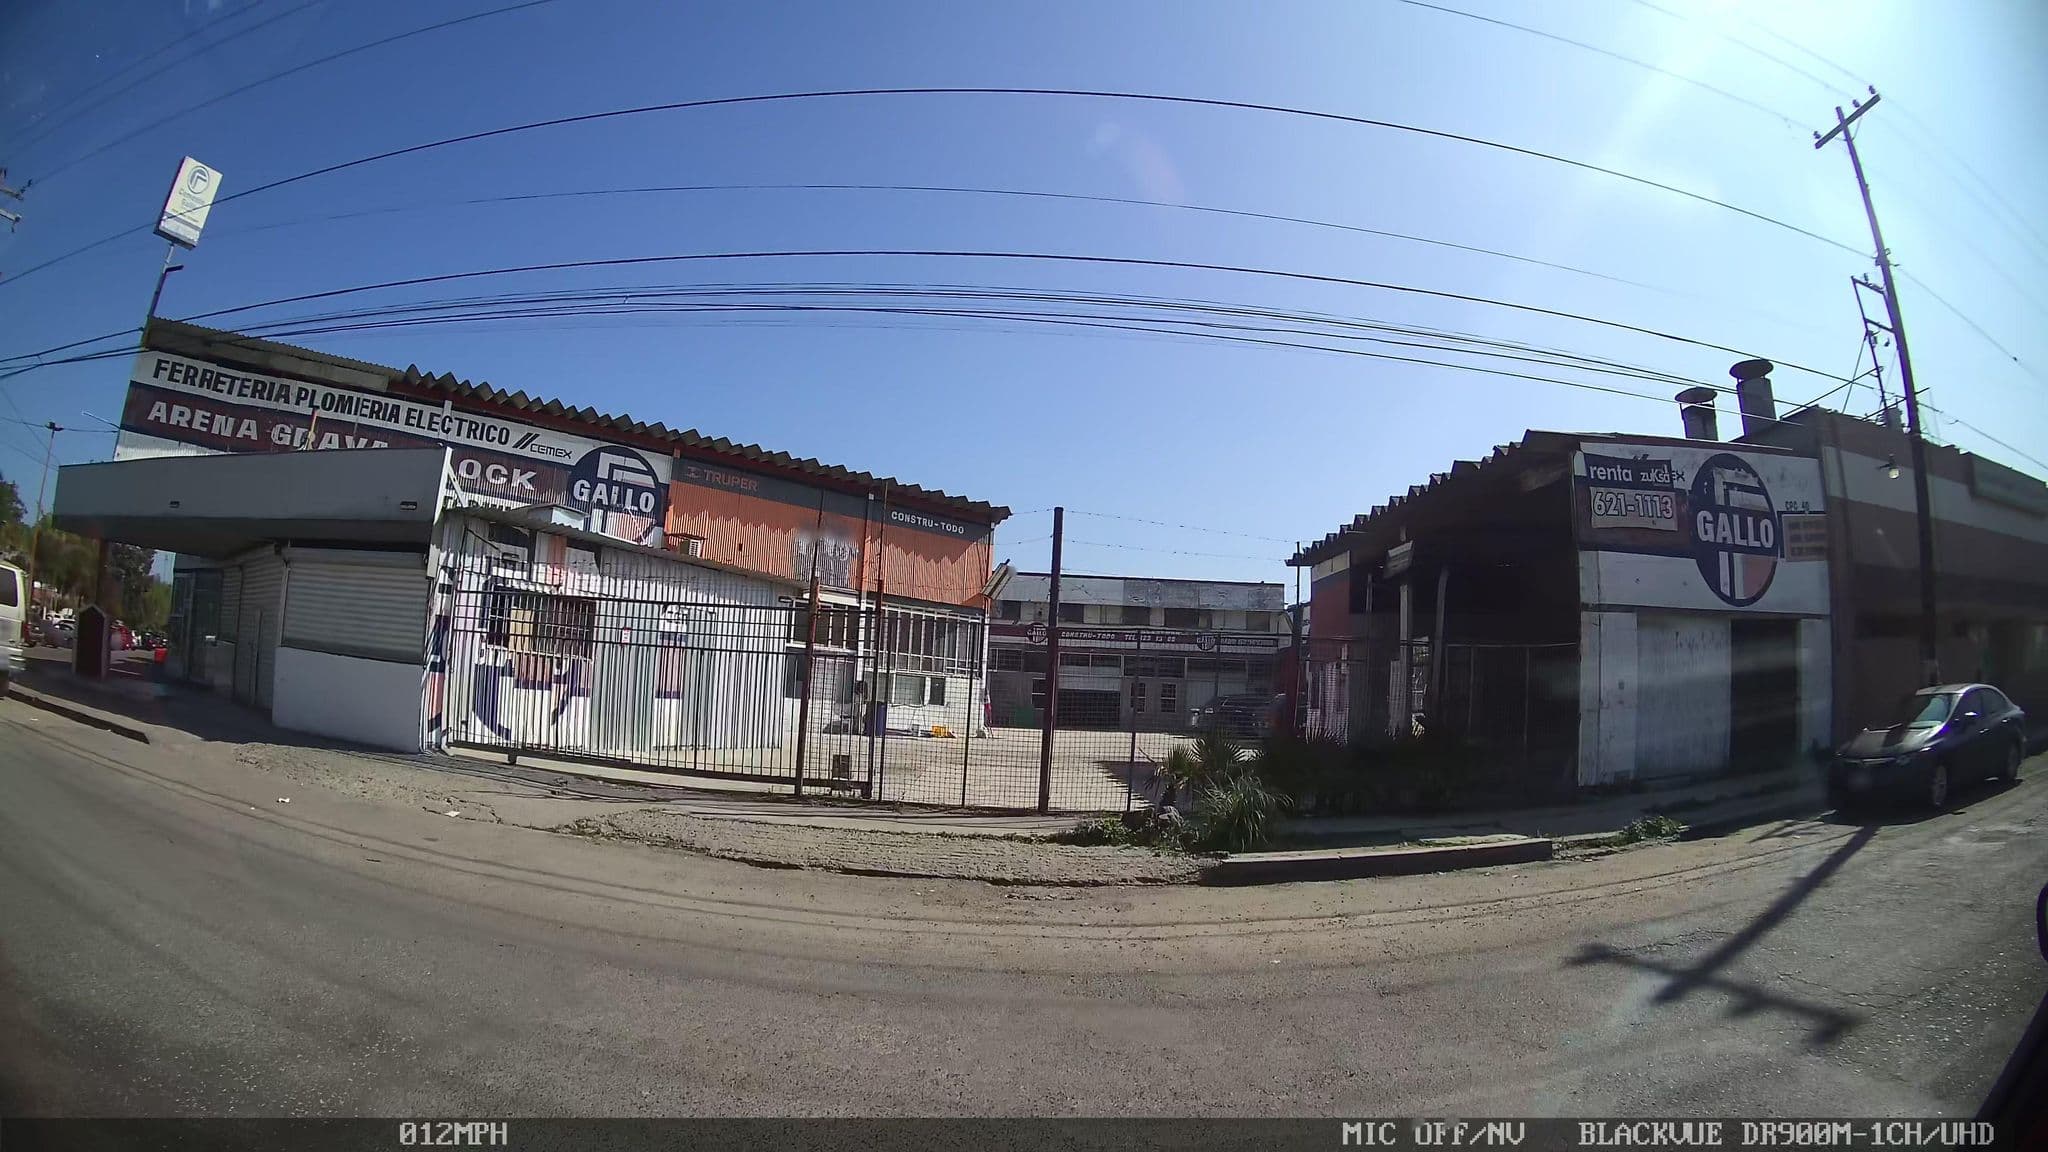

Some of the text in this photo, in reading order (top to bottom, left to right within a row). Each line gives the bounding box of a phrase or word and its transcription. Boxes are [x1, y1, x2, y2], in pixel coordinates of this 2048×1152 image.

[153, 358, 510, 446] FERRETERIA PLOMIERIA ELECTRICO
[147, 401, 258, 441] ARENA
[458, 458, 537, 491] OCK
[529, 443, 573, 459] CEMEX
[703, 469, 758, 493] TRUPER
[1589, 464, 1633, 482] renta
[572, 479, 655, 513] GALLO
[1593, 491, 1674, 519] 621-1113
[891, 511, 965, 534] CONSTRU-TODO
[1697, 510, 1774, 549] GALLO
